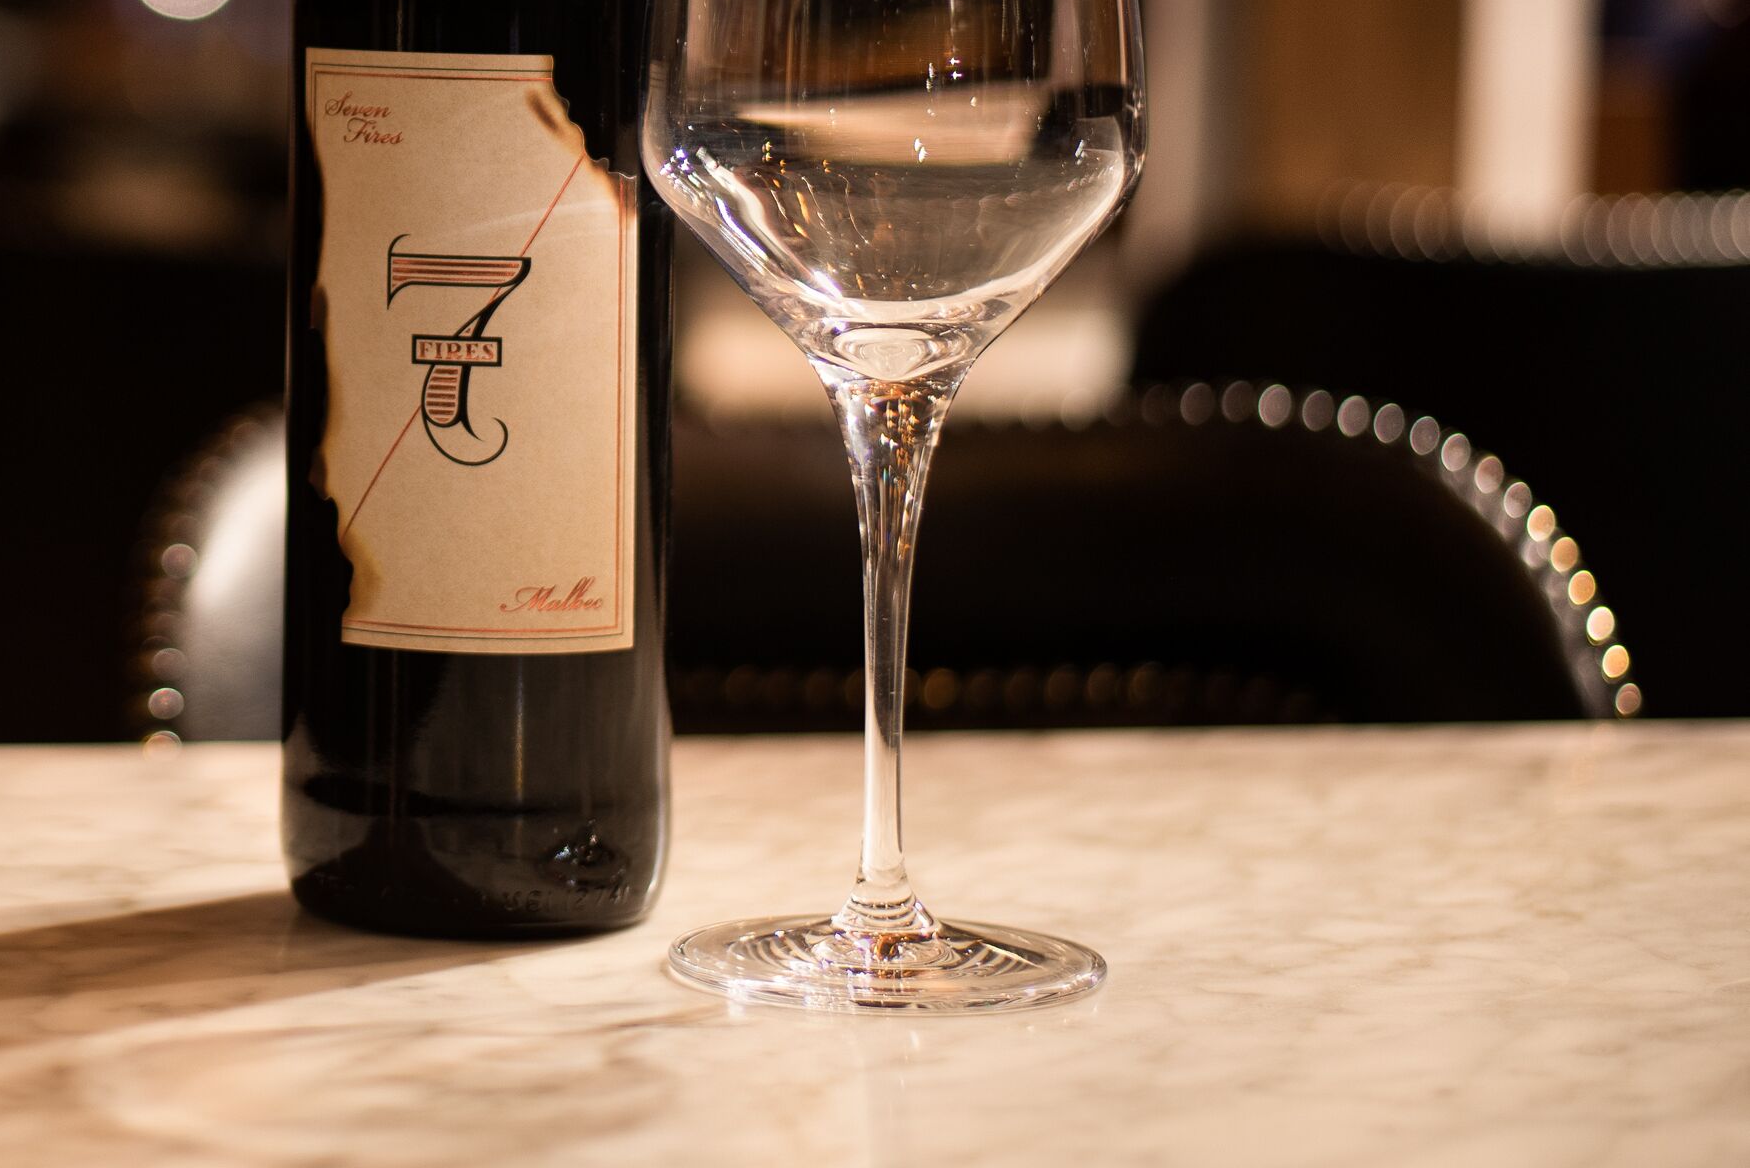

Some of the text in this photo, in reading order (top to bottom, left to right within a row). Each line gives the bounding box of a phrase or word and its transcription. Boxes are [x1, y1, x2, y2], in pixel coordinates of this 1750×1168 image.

[324, 90, 391, 118] Seven
[343, 116, 404, 145] Fires
[387, 233, 532, 467] 7
[418, 341, 495, 361] FIRES
[499, 575, 603, 612] Malbec
